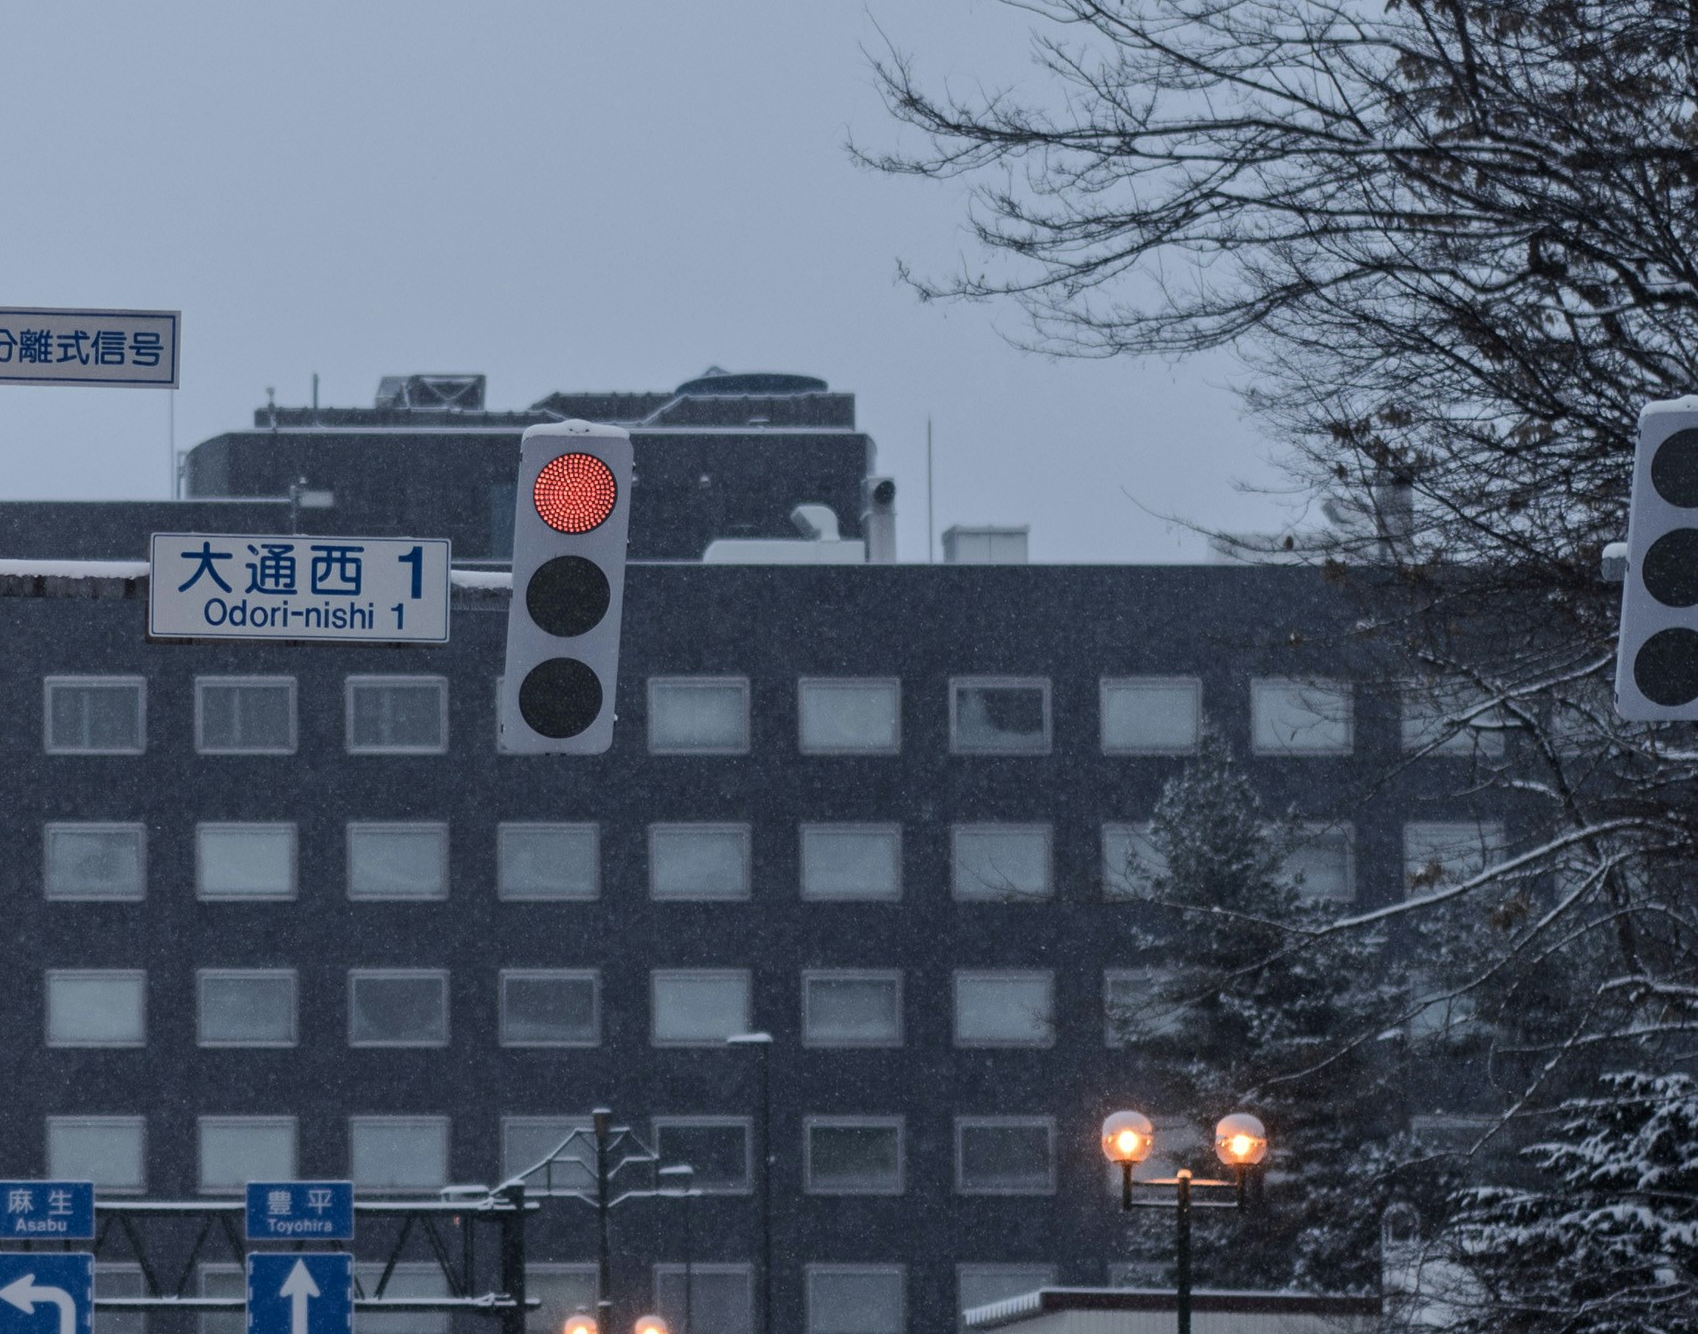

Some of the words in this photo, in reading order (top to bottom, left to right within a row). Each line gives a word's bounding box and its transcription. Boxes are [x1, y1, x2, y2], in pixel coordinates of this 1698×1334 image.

[204, 598, 375, 630] Odori-nishi
[391, 604, 405, 630] 1
[7, 1188, 74, 1216] 麻生
[266, 1189, 333, 1216] 豊平
[15, 1218, 67, 1233] Asabu
[267, 1219, 333, 1234] Toyohira
